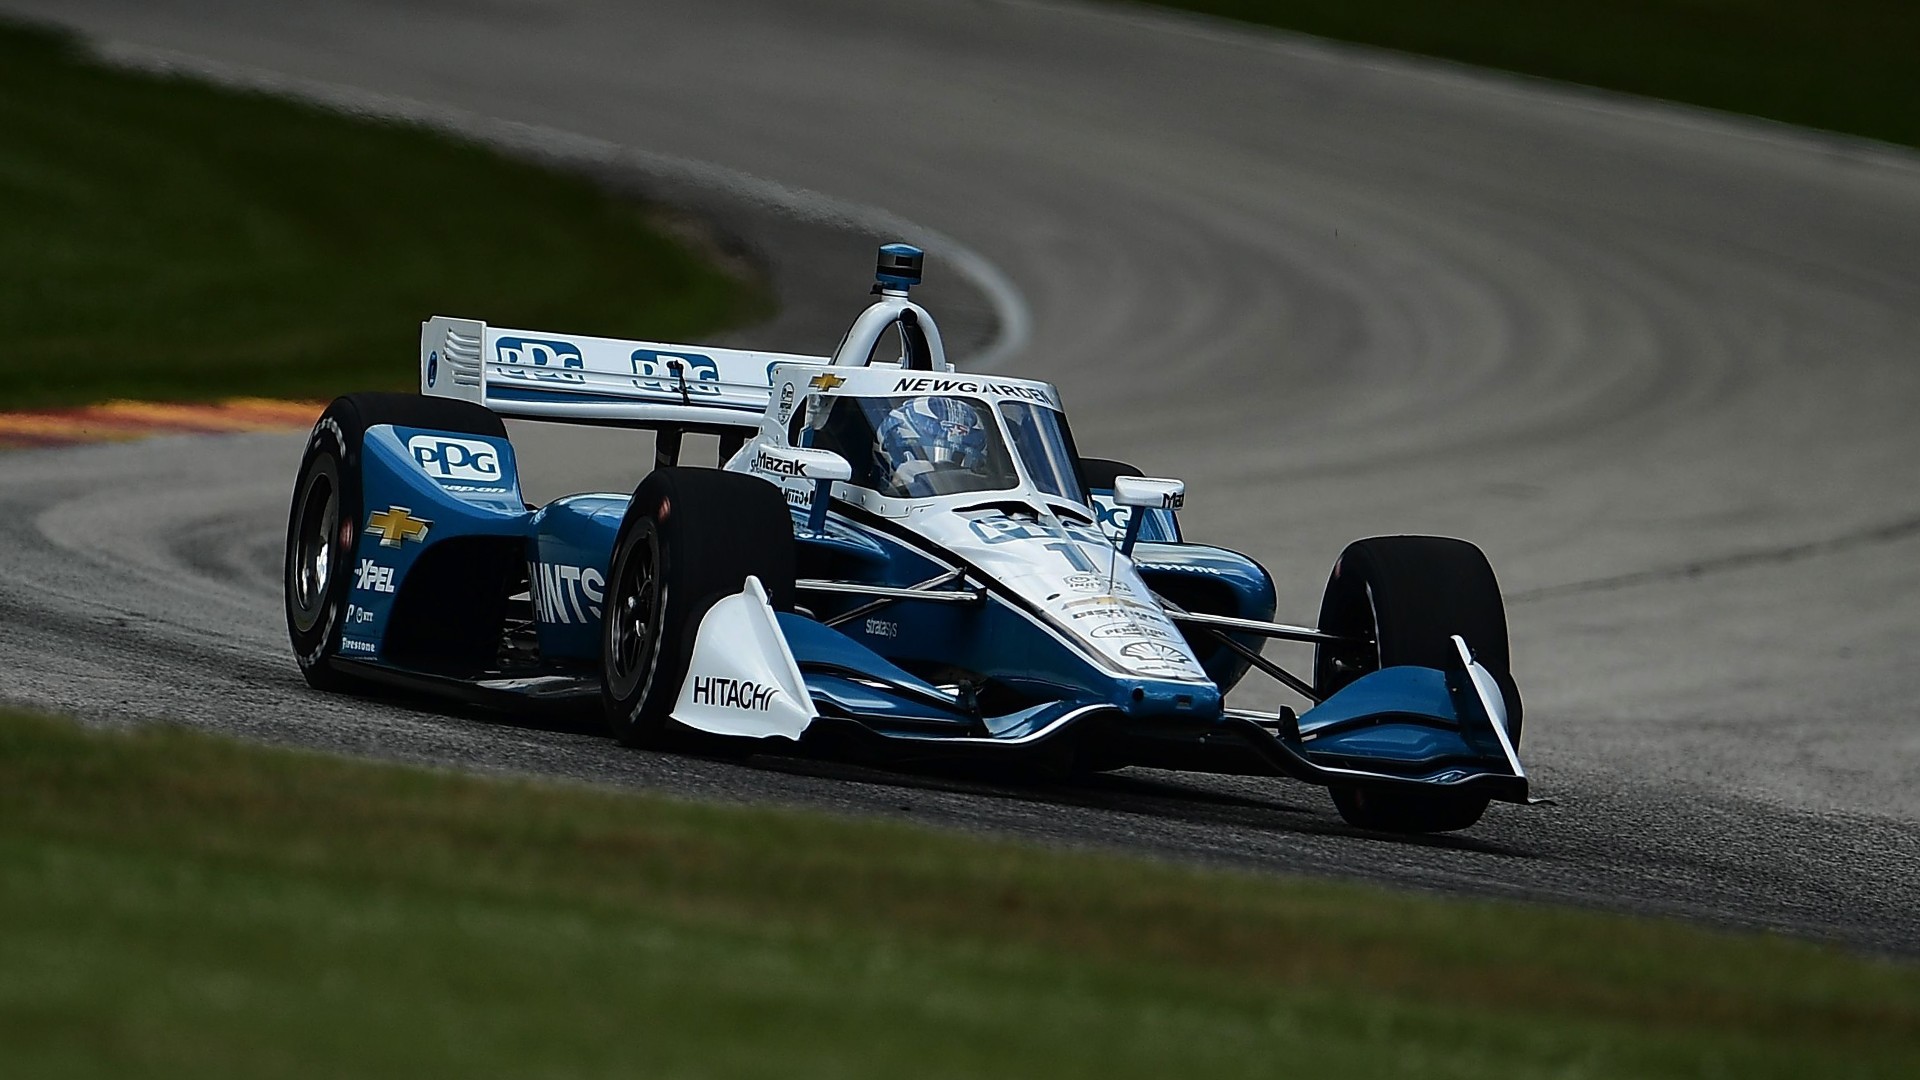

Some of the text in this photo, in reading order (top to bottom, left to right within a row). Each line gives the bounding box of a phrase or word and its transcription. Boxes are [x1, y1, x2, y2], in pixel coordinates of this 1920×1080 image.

[500, 342, 586, 383] PPG
[635, 355, 721, 395] PPG
[893, 377, 1054, 405] NEWGARDEN
[413, 441, 497, 475] PPG
[756, 449, 808, 478] Mazak
[356, 559, 395, 593] XPEL
[526, 561, 606, 624] AINTS
[342, 637, 376, 652] Firestone
[866, 617, 897, 639] stratasys
[693, 676, 780, 711] HITACHI
